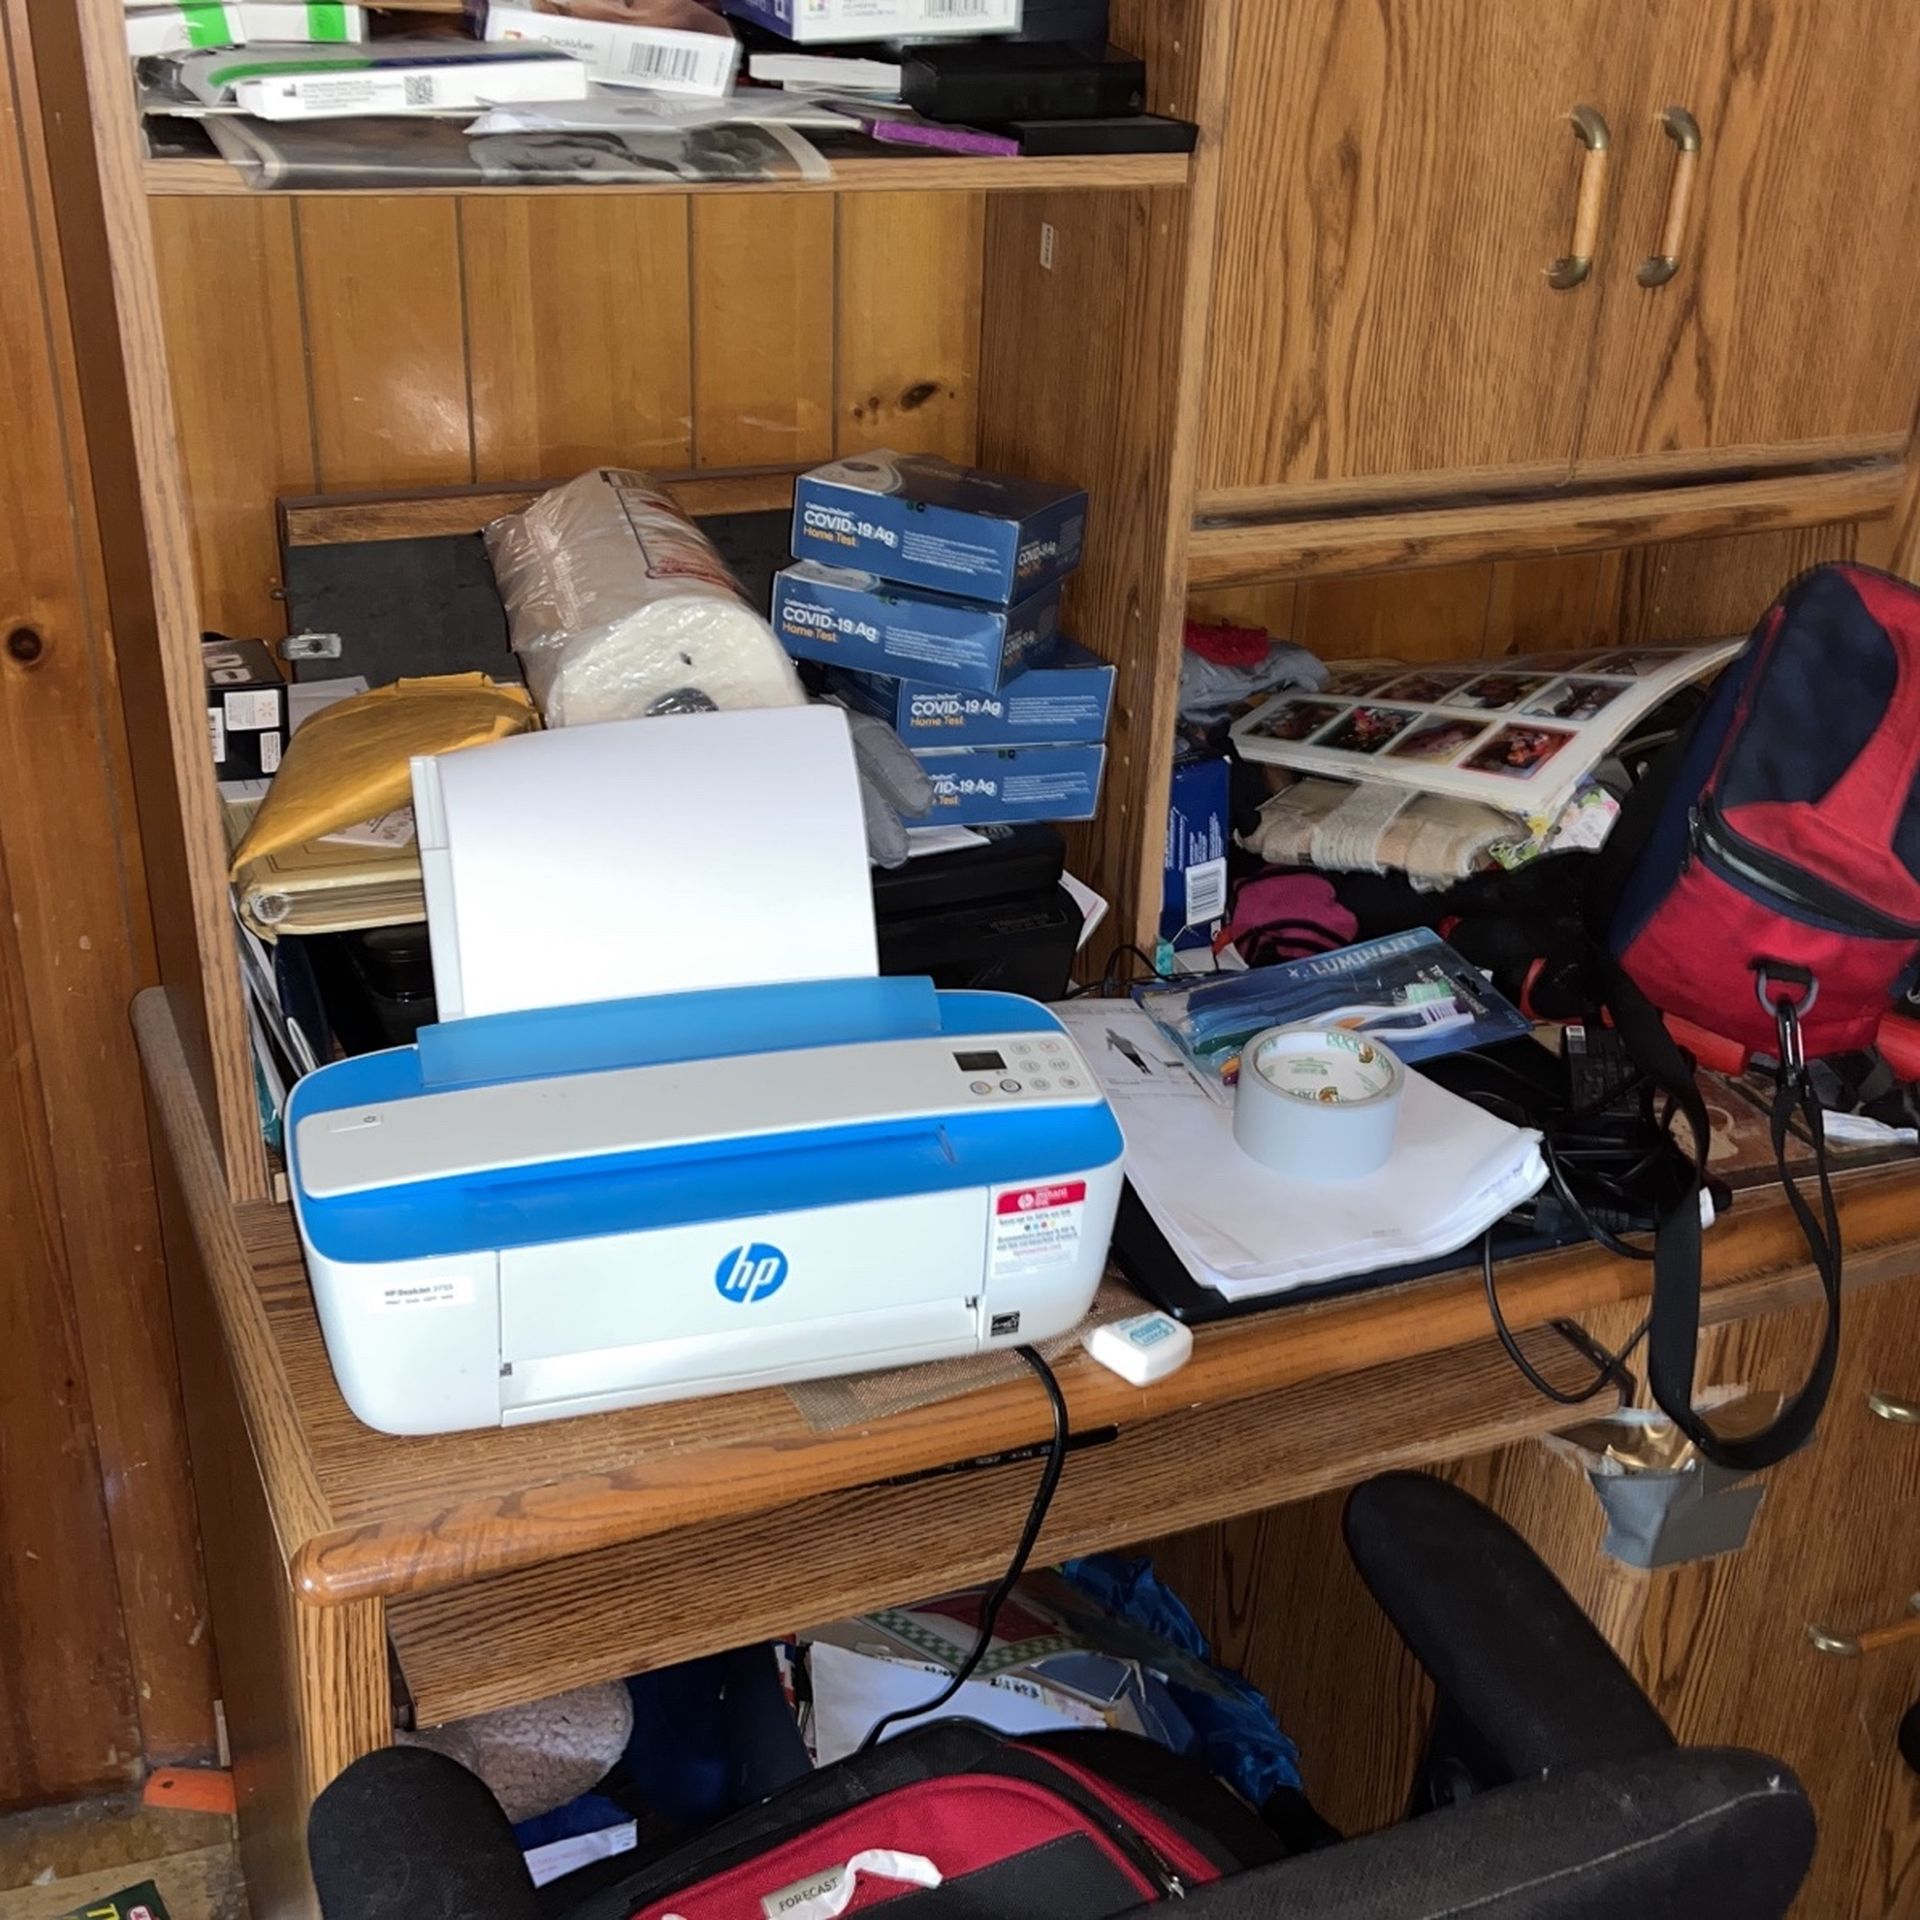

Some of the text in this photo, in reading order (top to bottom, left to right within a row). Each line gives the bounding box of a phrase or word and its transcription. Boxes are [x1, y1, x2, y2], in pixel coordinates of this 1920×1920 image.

[803, 510, 899, 548] COVID-19 Ag
[803, 526, 859, 547] Home Test
[782, 606, 853, 634] COVID-19
[853, 622, 880, 643] Ag
[782, 621, 838, 643] Home Test
[910, 698, 979, 717] COVID-19
[980, 699, 1003, 718] Ag
[910, 714, 965, 727] Home Test
[975, 779, 998, 797] Ag
[719, 1242, 784, 1303] hp
[778, 1876, 839, 1912] FORECAST
